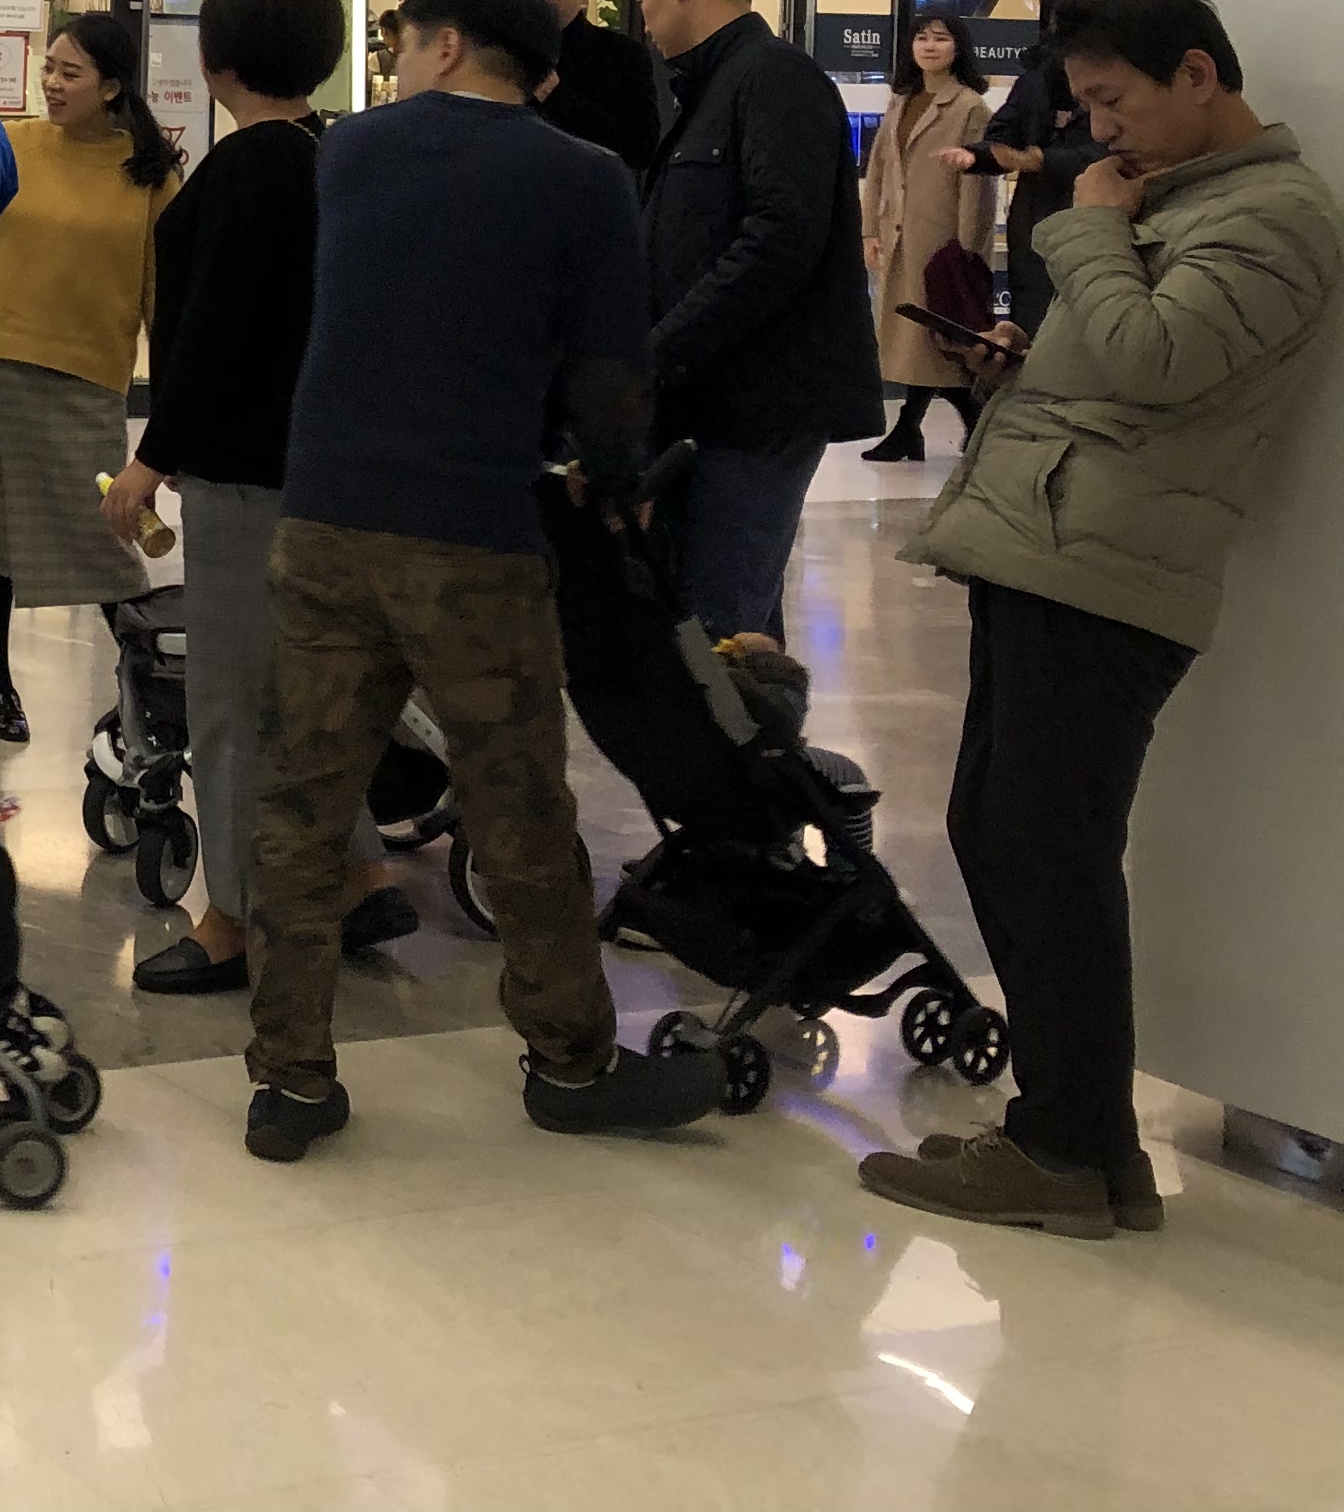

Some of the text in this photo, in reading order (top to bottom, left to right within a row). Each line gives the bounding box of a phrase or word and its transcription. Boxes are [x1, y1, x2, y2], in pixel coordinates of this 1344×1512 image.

[843, 29, 881, 44] Satin
[974, 46, 1027, 59] BEAUTY
[164, 91, 192, 104] 이벤트
